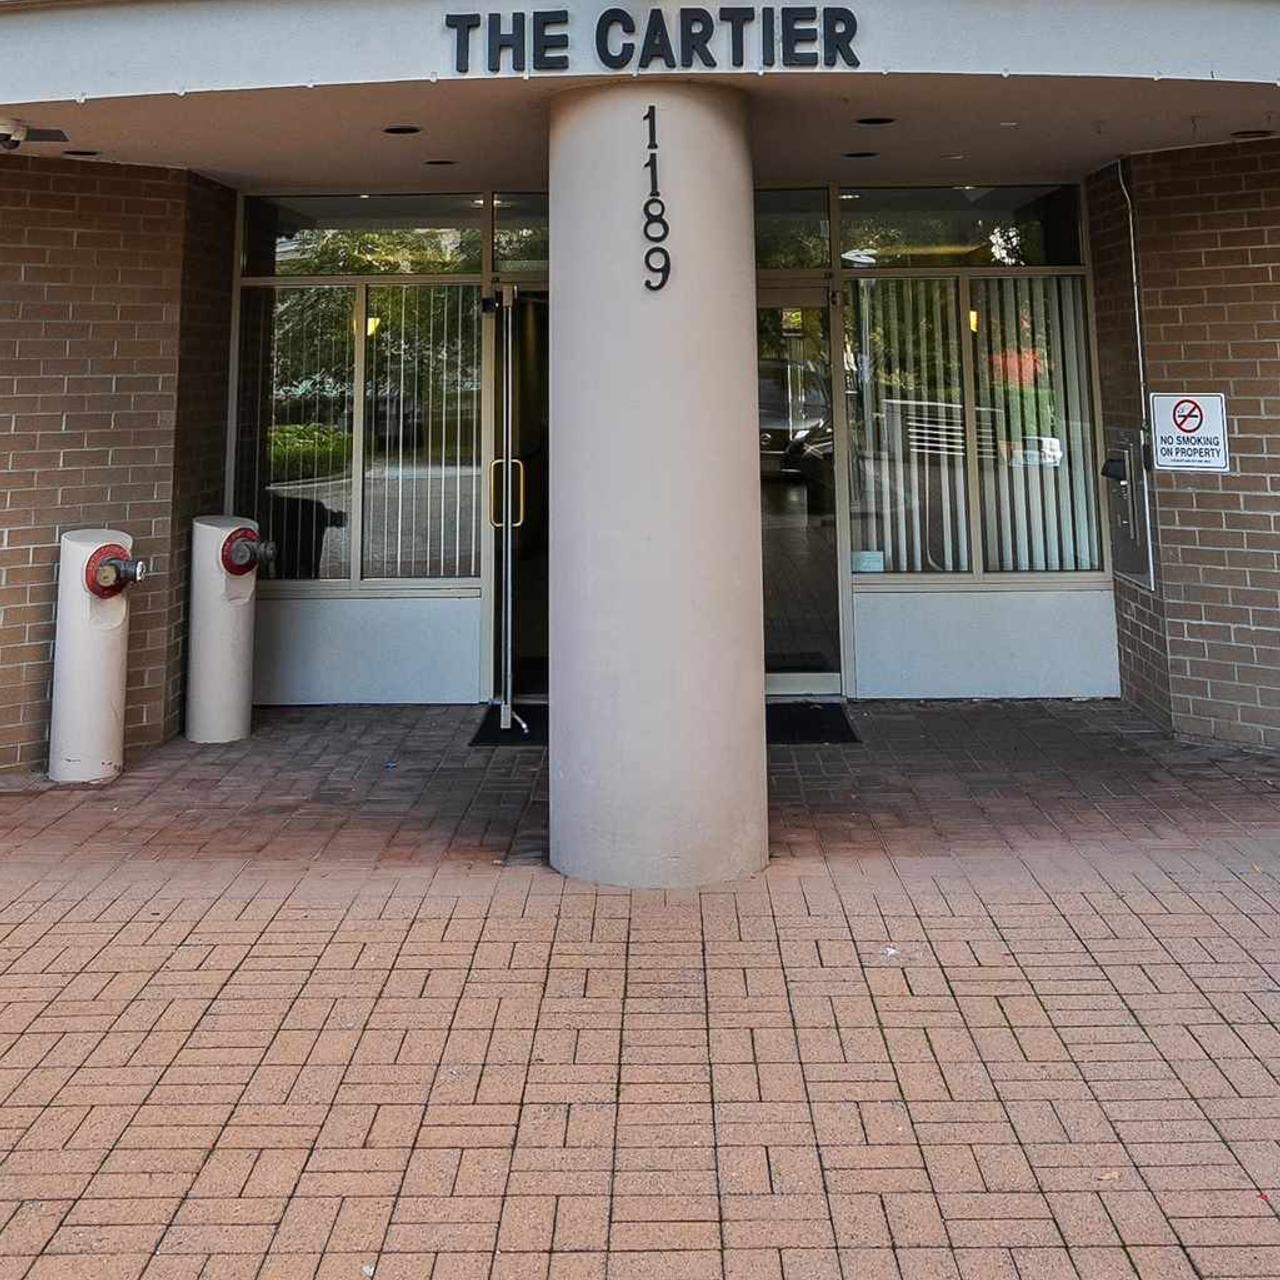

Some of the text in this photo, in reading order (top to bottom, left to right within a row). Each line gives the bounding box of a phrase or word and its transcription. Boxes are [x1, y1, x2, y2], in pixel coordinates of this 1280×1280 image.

[445, 6, 861, 73] THE CARTIER
[642, 105, 671, 291] 1189
[1160, 435, 1220, 446] NO SMOKING
[1160, 447, 1221, 458] ON PROPERTY
